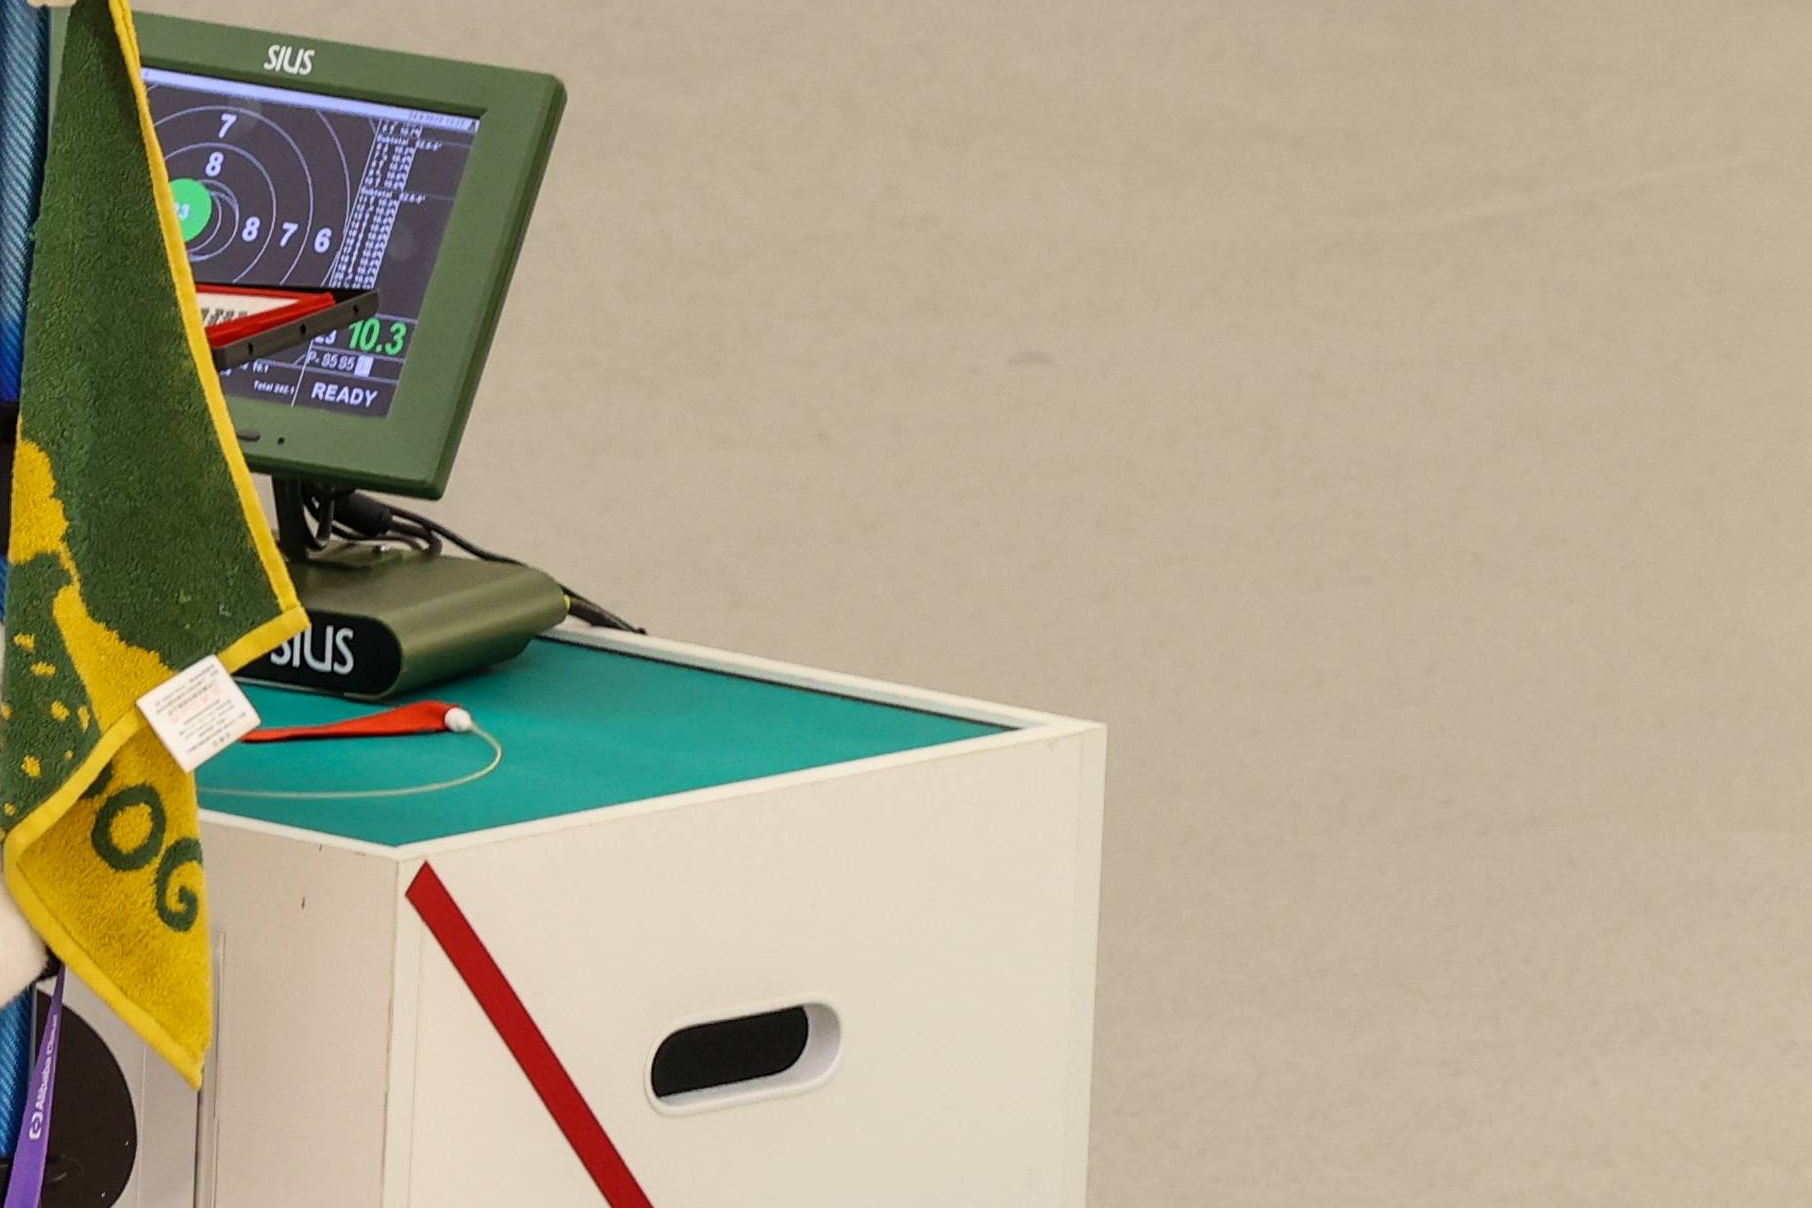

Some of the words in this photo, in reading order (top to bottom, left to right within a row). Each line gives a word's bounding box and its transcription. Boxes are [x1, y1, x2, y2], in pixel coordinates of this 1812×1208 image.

[263, 44, 315, 75] SIUS
[218, 113, 237, 139] 7
[205, 151, 224, 177] 8
[242, 216, 261, 241] 8
[280, 222, 299, 247] 7
[314, 228, 332, 253] 6
[349, 317, 407, 355] 10.3
[311, 381, 379, 408] READY
[80, 761, 203, 933] OG
[35, 1056, 52, 1111] Alibaba
